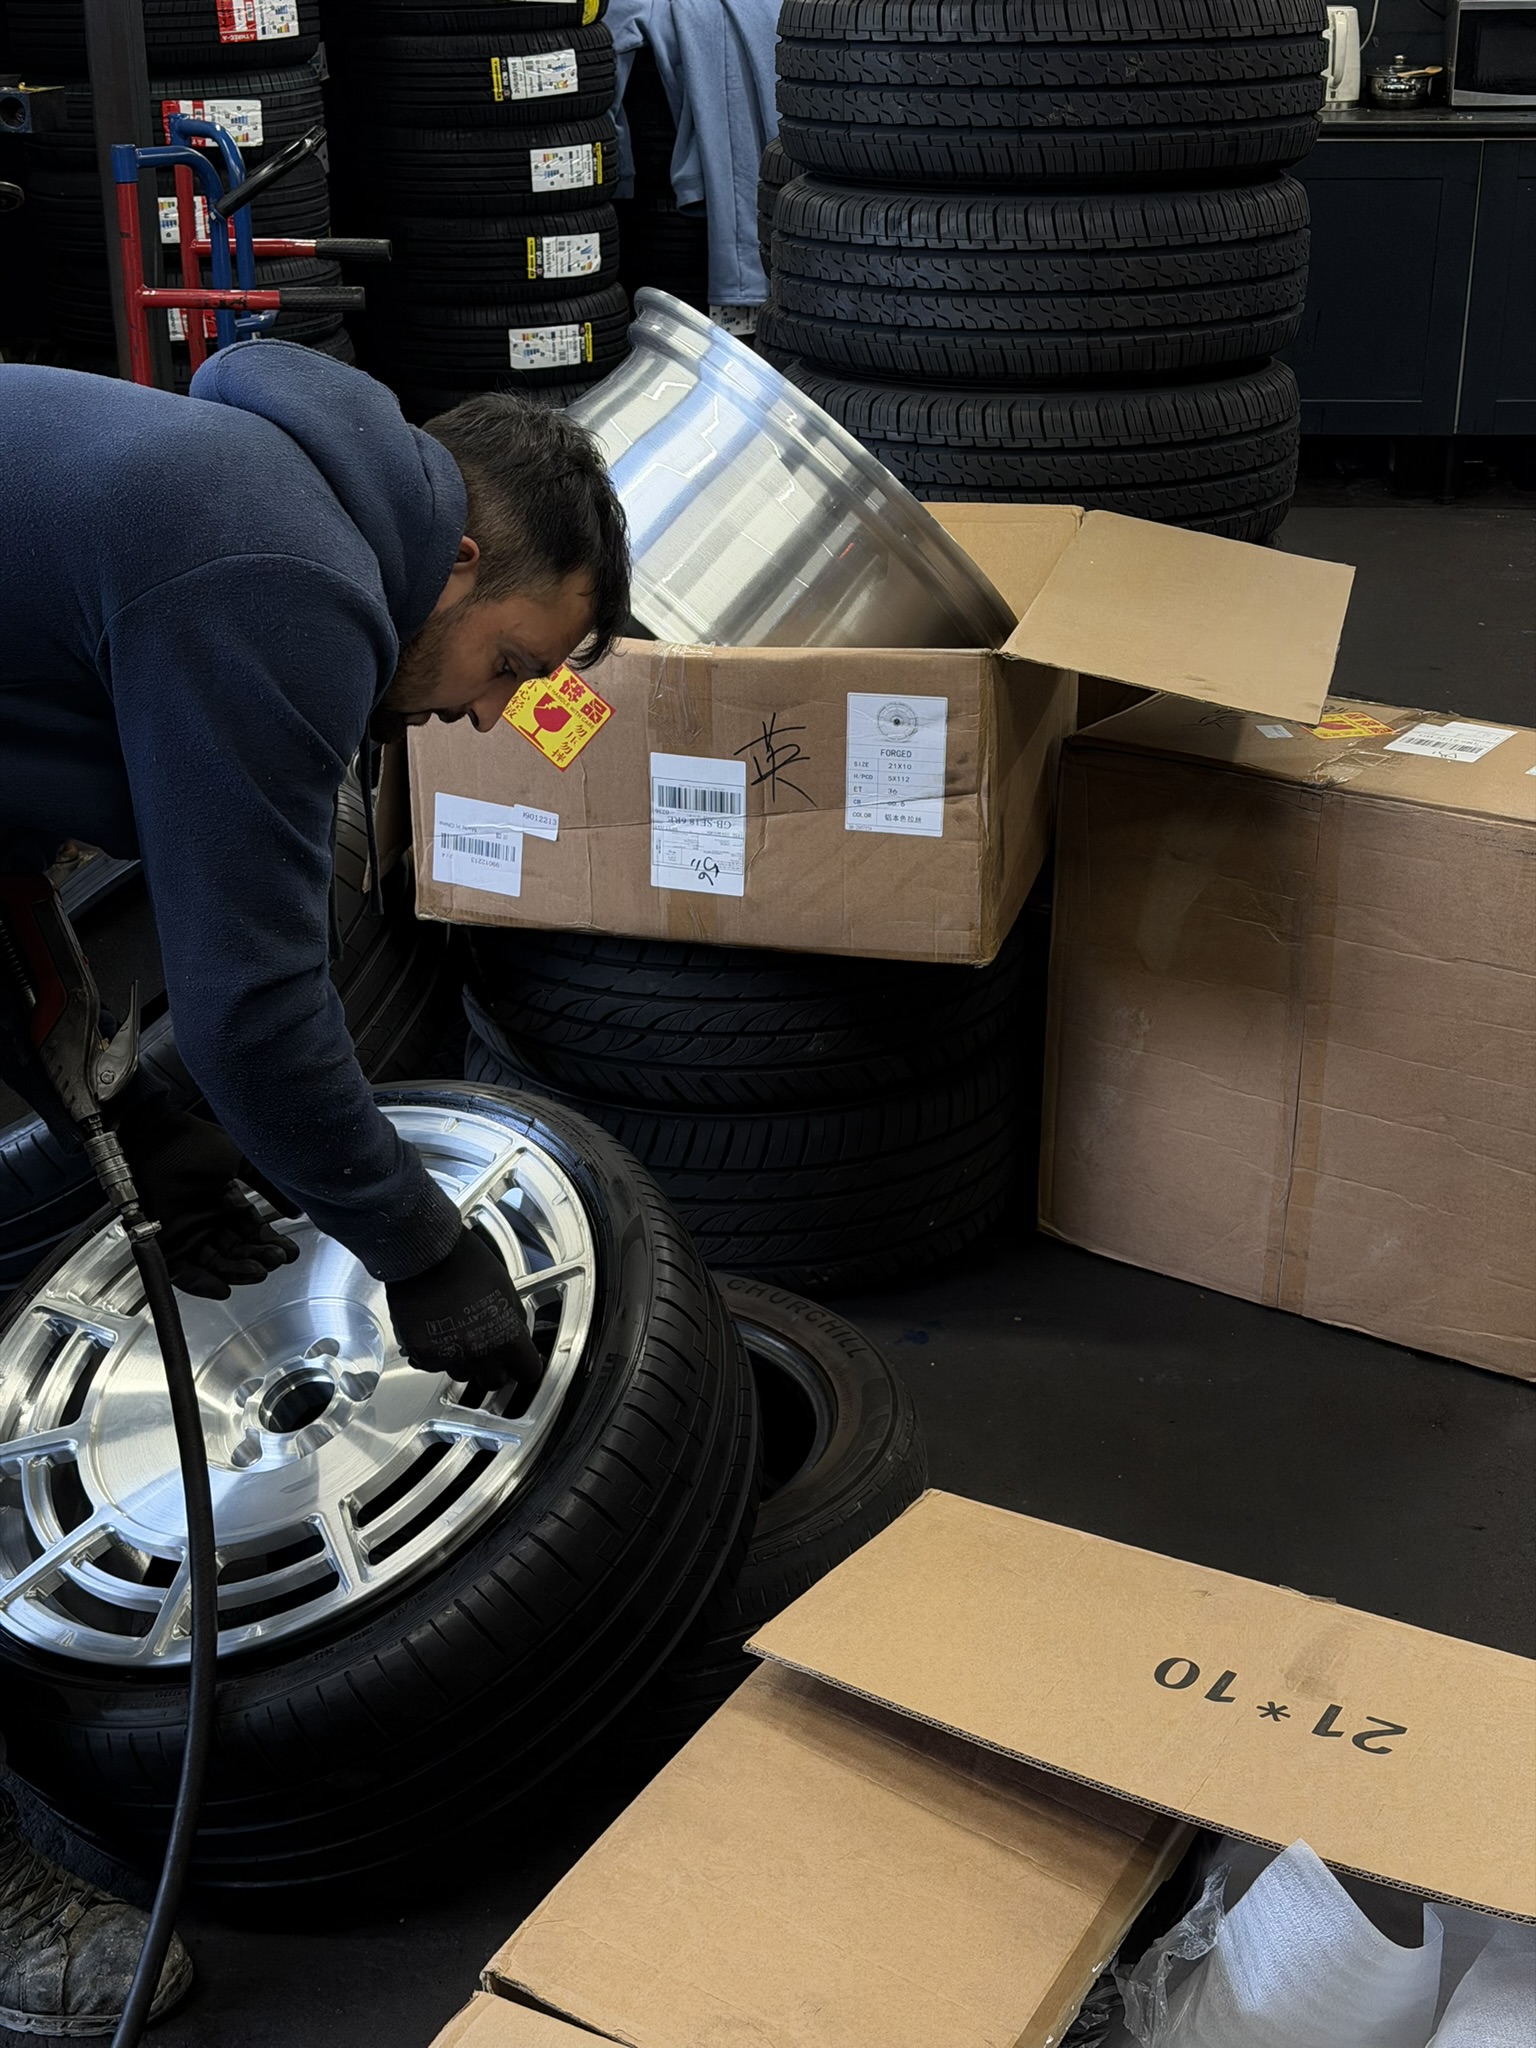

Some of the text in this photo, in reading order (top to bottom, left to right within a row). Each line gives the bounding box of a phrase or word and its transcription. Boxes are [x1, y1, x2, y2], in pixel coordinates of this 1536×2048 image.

[551, 687, 571, 708] HANDLE
[569, 706, 583, 720] WITH
[580, 716, 596, 730] CARE
[880, 748, 912, 758] FORGED
[888, 762, 912, 770] 21X10
[888, 775, 910, 783] 5X112
[439, 820, 455, 828] China
[690, 817, 732, 830] GB-SE18
[471, 856, 500, 868] 99012213
[726, 1278, 868, 1359] CHURCHILL
